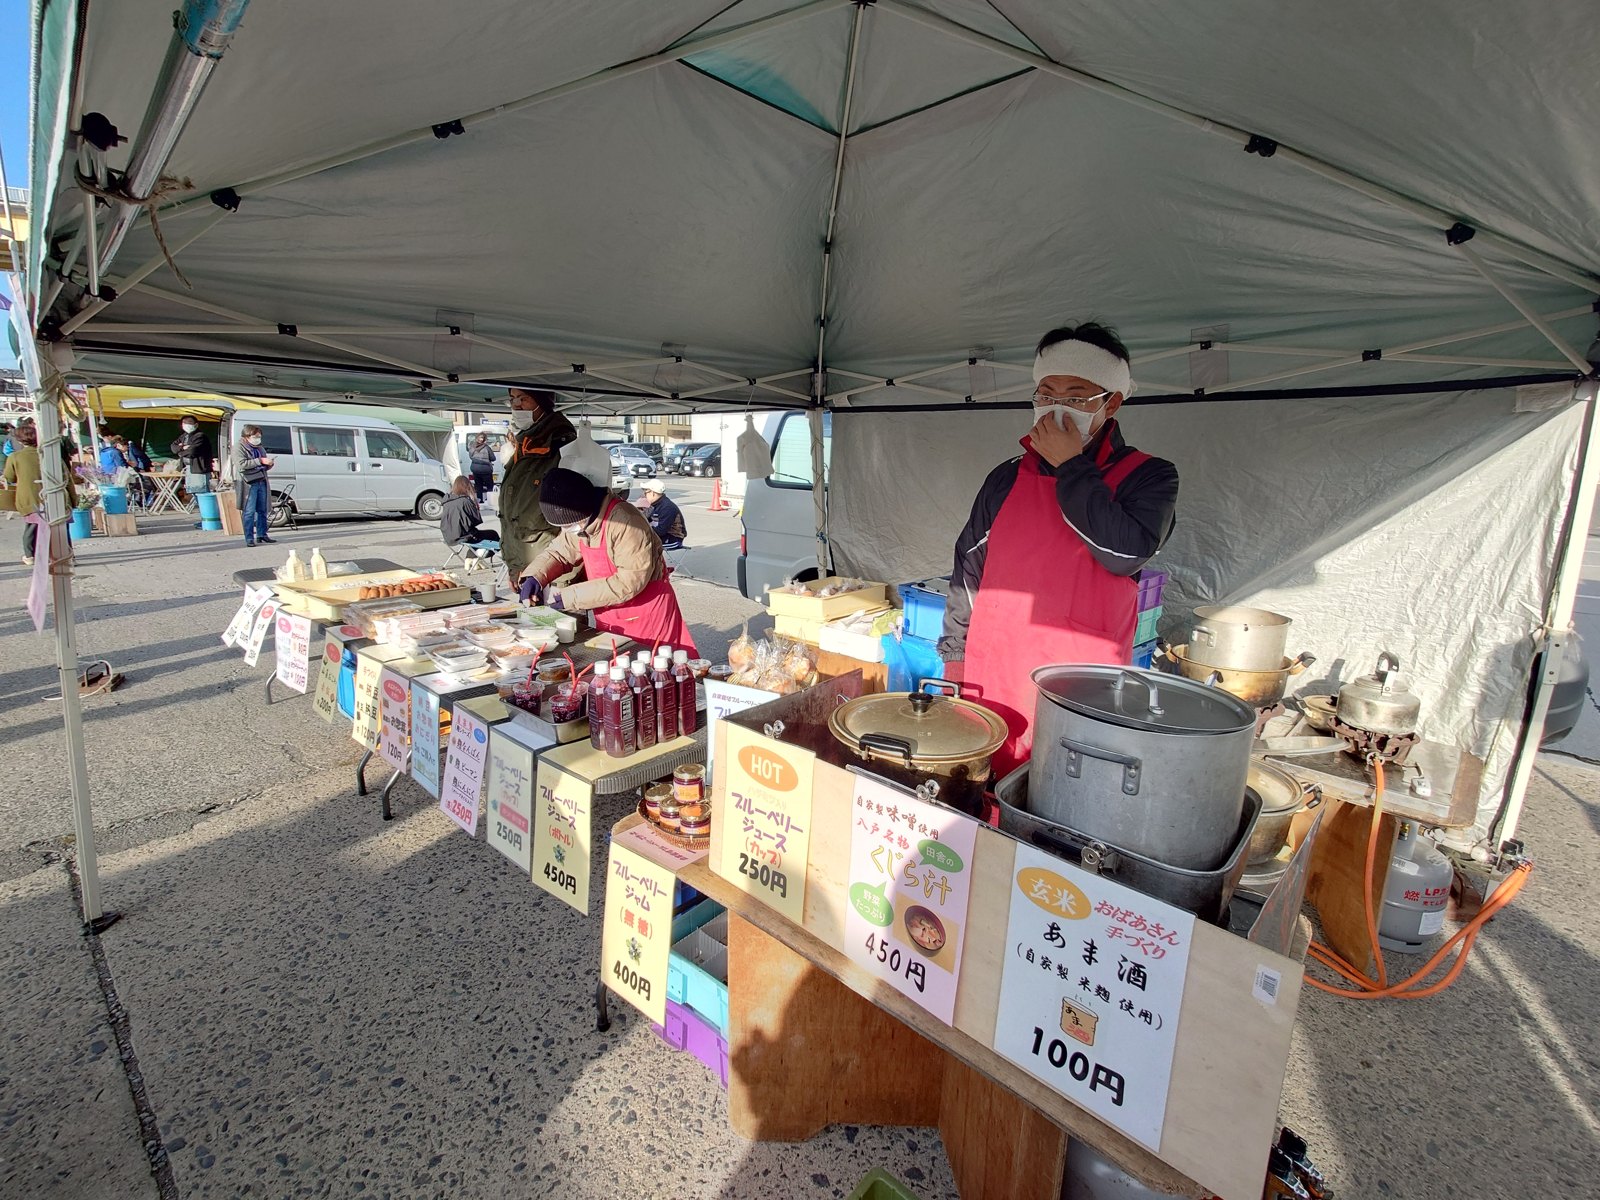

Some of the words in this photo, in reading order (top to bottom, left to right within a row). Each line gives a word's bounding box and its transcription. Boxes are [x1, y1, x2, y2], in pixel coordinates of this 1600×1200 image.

[387, 741, 402, 761] 120円
[494, 755, 528, 782] ブルーベリー
[499, 772, 521, 797] ジュース
[751, 753, 783, 784] HOT
[540, 785, 586, 815] ブルーベリー
[547, 803, 577, 830] ジュース
[731, 791, 803, 833] ブルーベリー
[496, 821, 522, 851] 250円
[742, 816, 787, 853] ジュース
[857, 817, 910, 850] 八戸名物
[745, 836, 782, 869] (カップ)
[926, 846, 954, 867] 田舎の
[543, 861, 577, 895] 450円
[612, 859, 667, 897] ブルーベリー
[738, 852, 787, 899] 250円
[870, 844, 953, 906] くじら汁
[625, 884, 650, 912] ジャム
[855, 899, 886, 922] たっぷり
[863, 888, 881, 907] 野菜
[1029, 878, 1077, 915] 玄米
[1404, 890, 1420, 902] 燃
[1093, 901, 1181, 947] おばあさん
[1042, 921, 1148, 992] あま酒
[1105, 925, 1167, 960] 手づくり
[865, 932, 926, 993] 450円
[613, 960, 651, 1002] 400円
[1031, 1026, 1125, 1107] 100円
